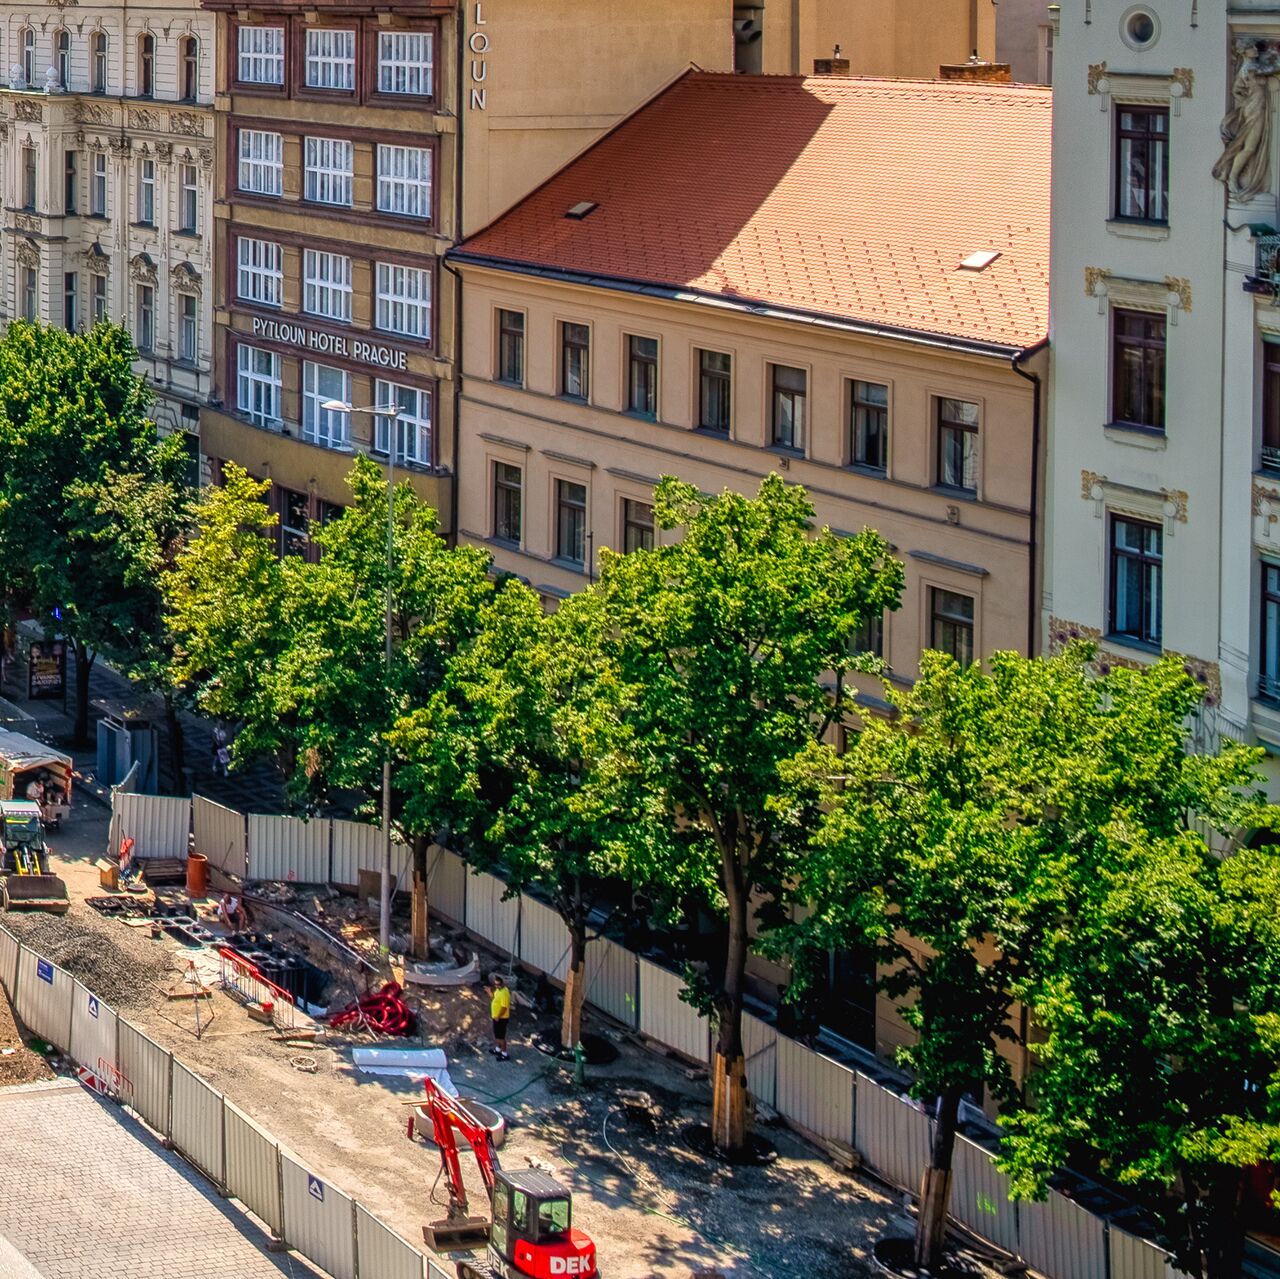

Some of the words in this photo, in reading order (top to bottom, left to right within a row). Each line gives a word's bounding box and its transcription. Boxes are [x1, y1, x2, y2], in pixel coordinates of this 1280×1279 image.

[253, 317, 307, 347] PYTLOUN
[310, 330, 349, 357] HOTEL
[353, 341, 408, 371] PRAGUE
[550, 1254, 591, 1275] DEK
